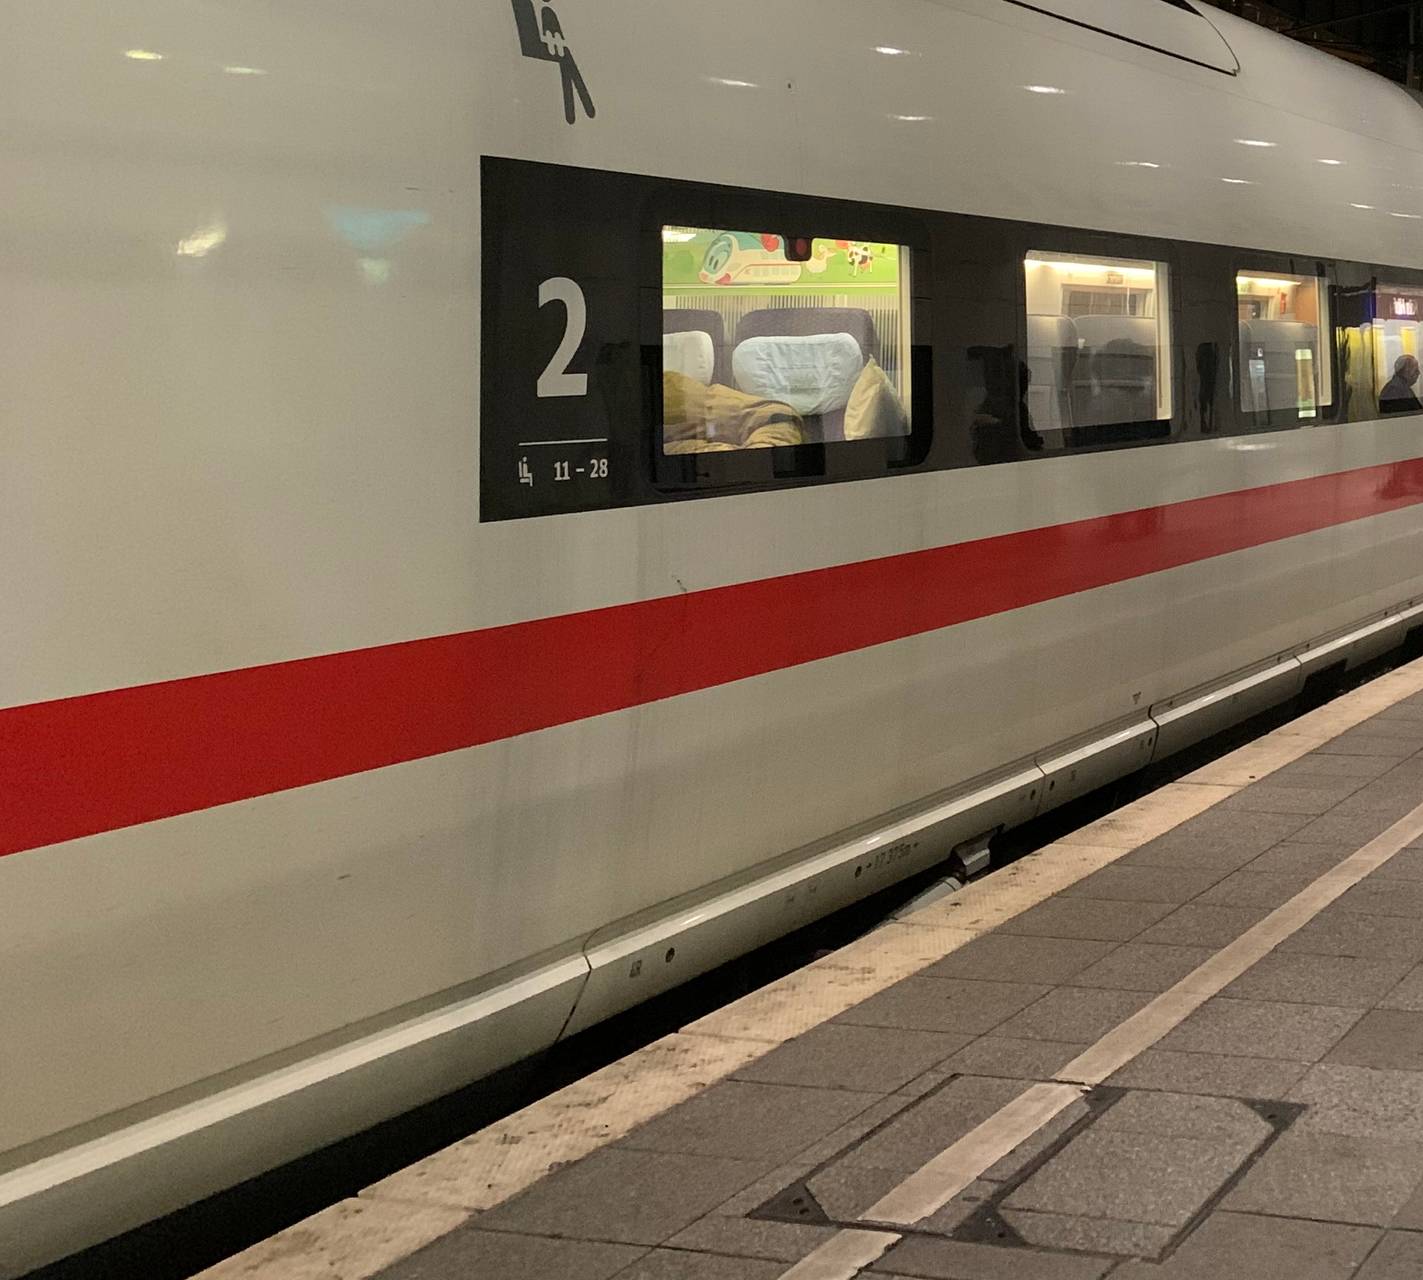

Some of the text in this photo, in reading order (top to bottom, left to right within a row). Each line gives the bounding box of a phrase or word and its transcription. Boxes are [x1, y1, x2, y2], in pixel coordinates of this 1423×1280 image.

[537, 277, 588, 397] 2
[554, 460, 571, 480] 11
[590, 458, 608, 479] 28
